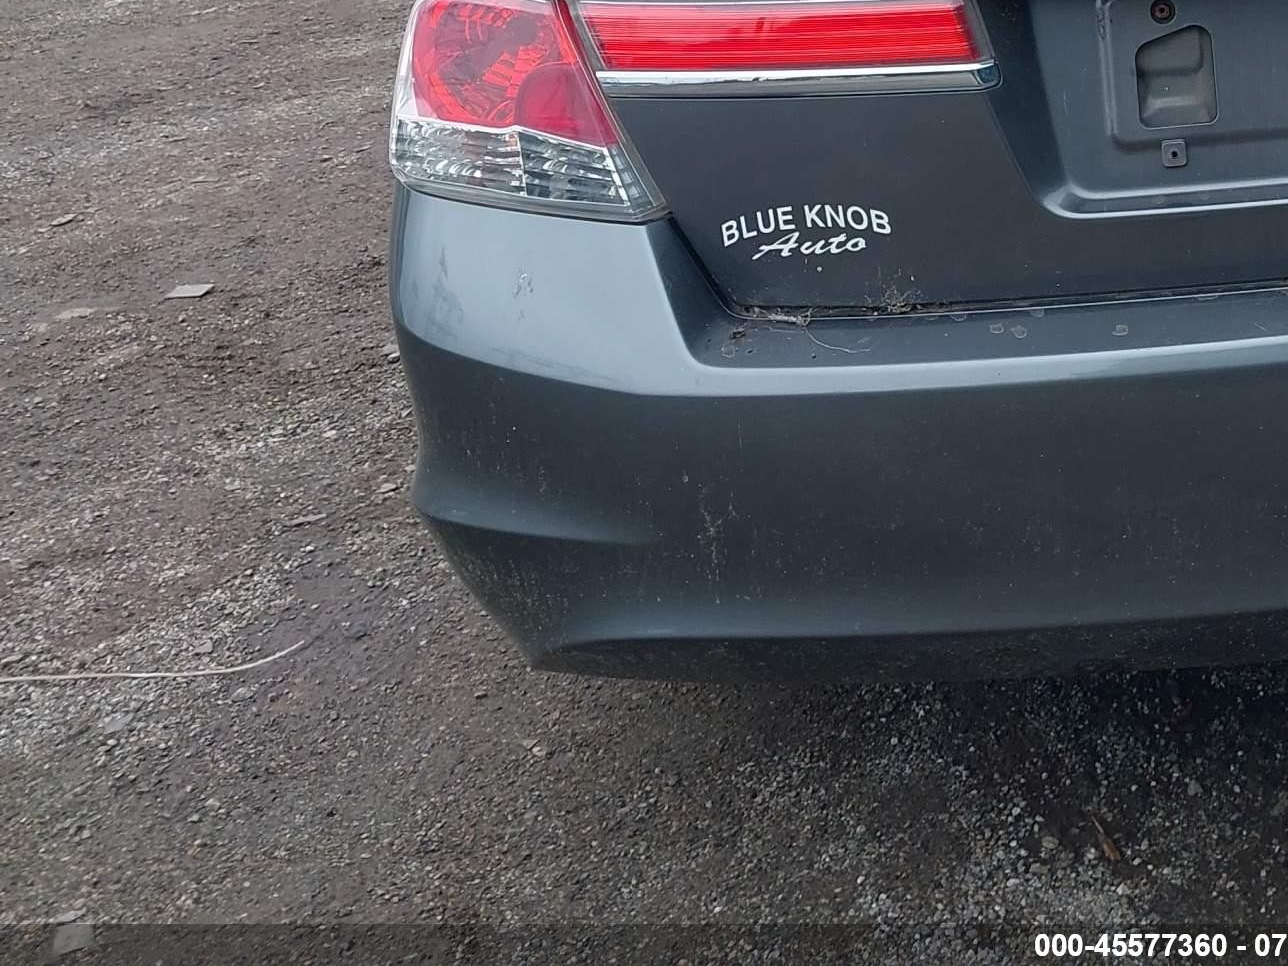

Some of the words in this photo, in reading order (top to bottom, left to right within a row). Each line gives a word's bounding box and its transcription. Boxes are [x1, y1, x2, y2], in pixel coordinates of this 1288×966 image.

[720, 205, 796, 248] BLUE
[803, 204, 892, 235] KNOB
[751, 231, 867, 261] Auto
